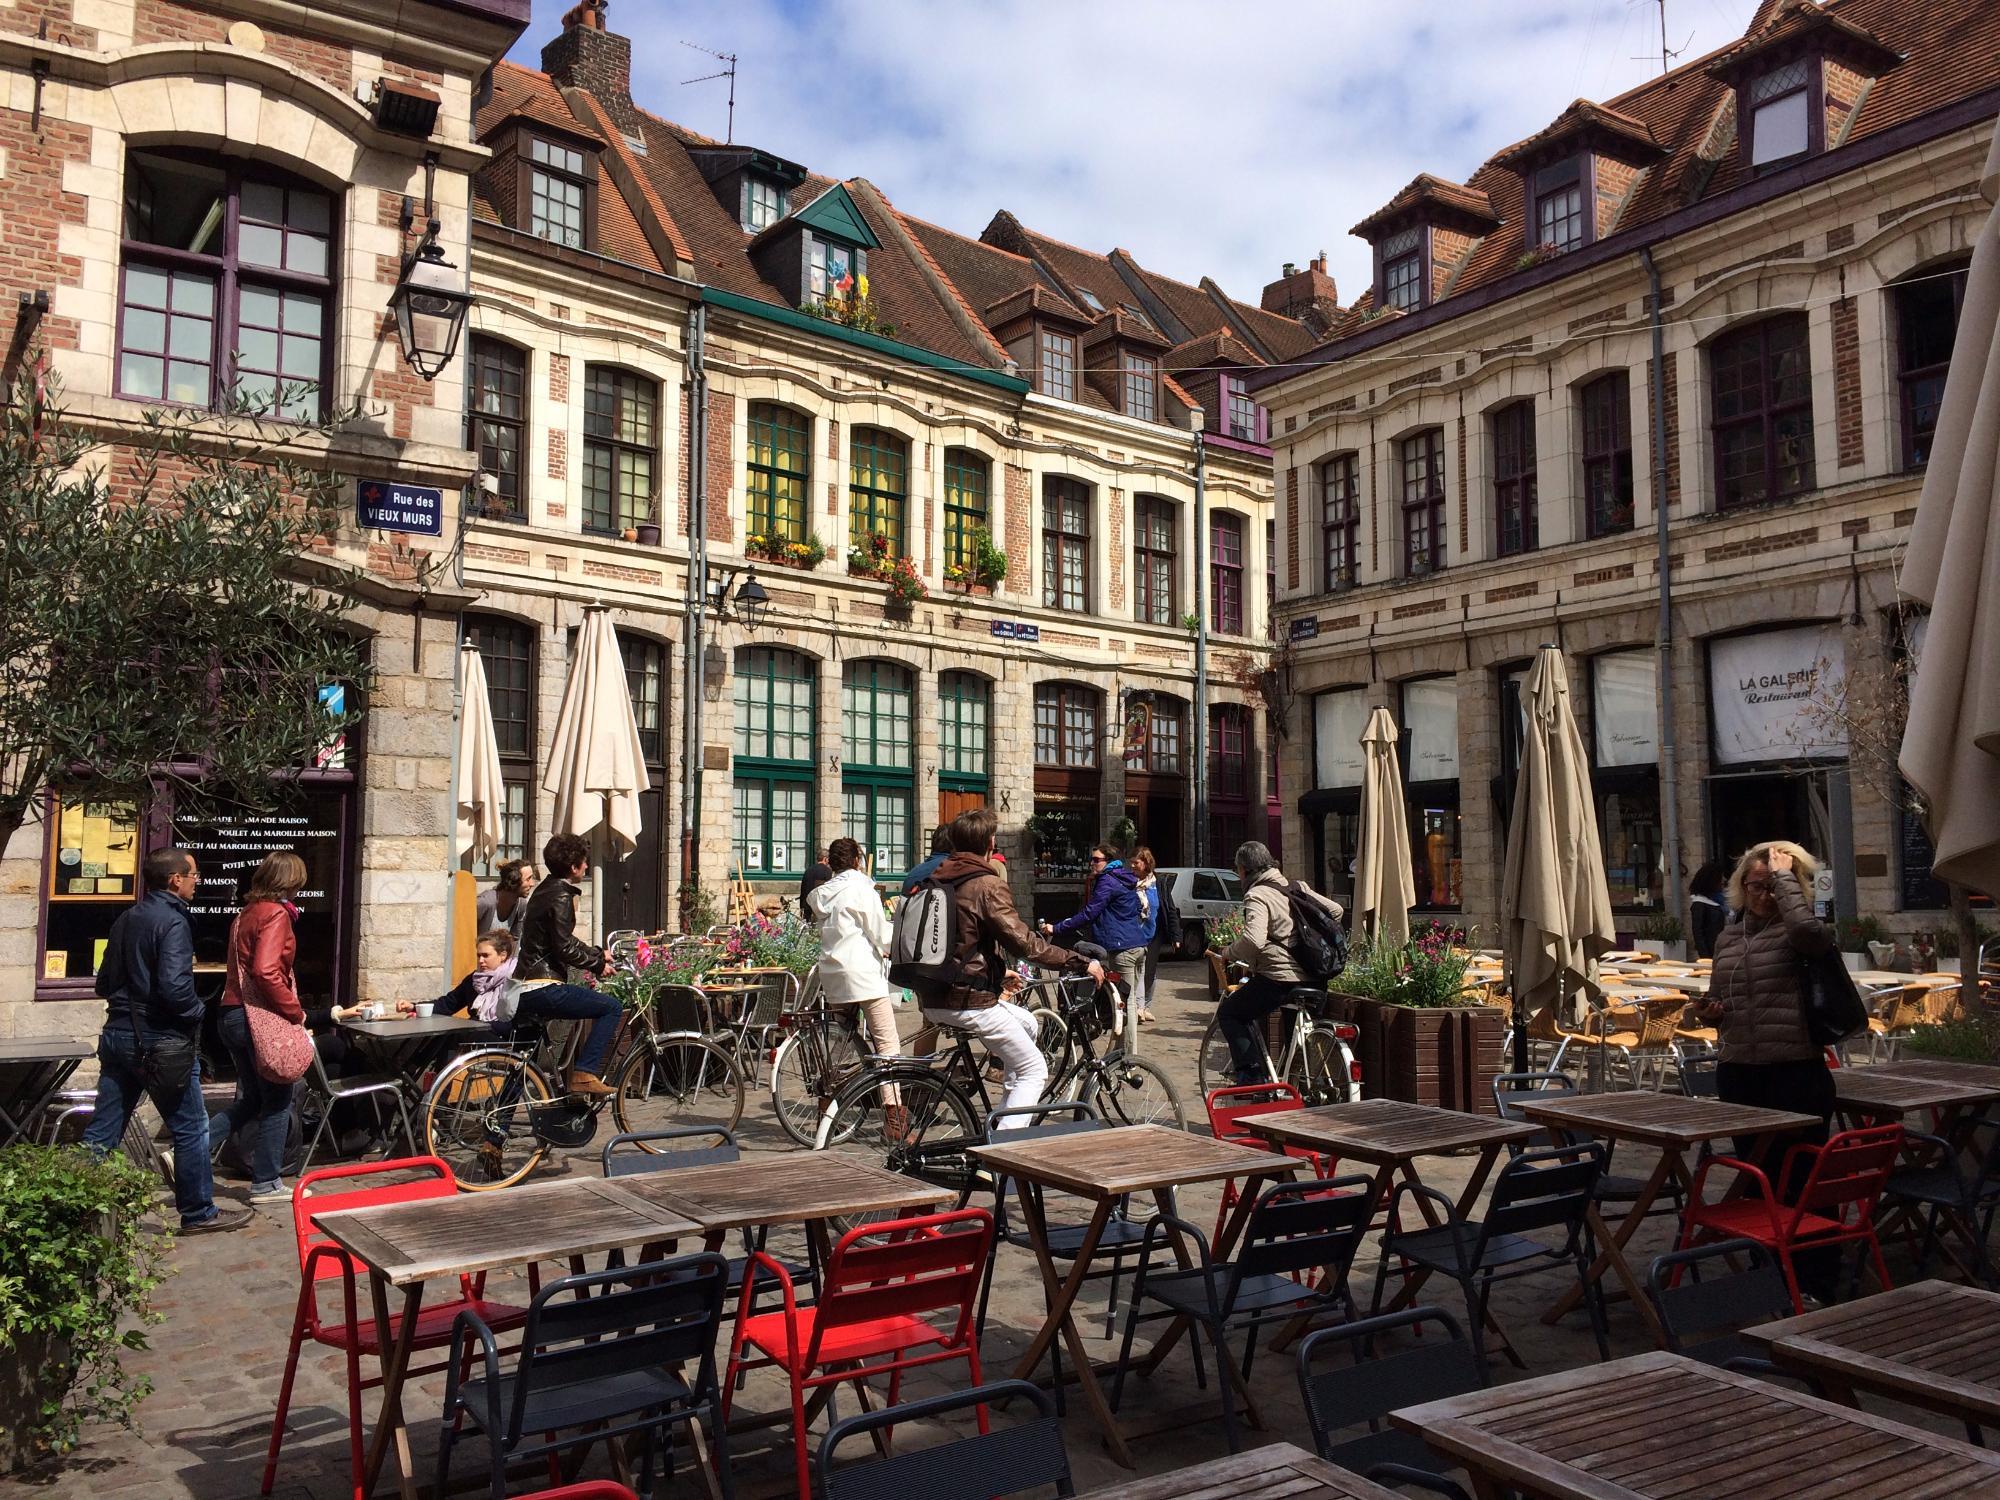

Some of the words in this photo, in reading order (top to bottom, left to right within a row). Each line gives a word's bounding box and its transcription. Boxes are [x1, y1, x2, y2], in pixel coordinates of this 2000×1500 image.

[394, 493, 412, 505] Rue
[416, 496, 433, 508] des
[368, 507, 399, 522] VIEUX
[402, 511, 433, 526] MURS
[1739, 678, 1757, 691] LA
[278, 816, 309, 824] MAISON
[218, 829, 249, 837] POULET
[250, 829, 262, 837] AU
[175, 842, 204, 850] WELCH
[205, 842, 218, 850] AU
[263, 843, 295, 851] MAISON
[222, 861, 246, 870] POTJE
[208, 906, 221, 914] AU
